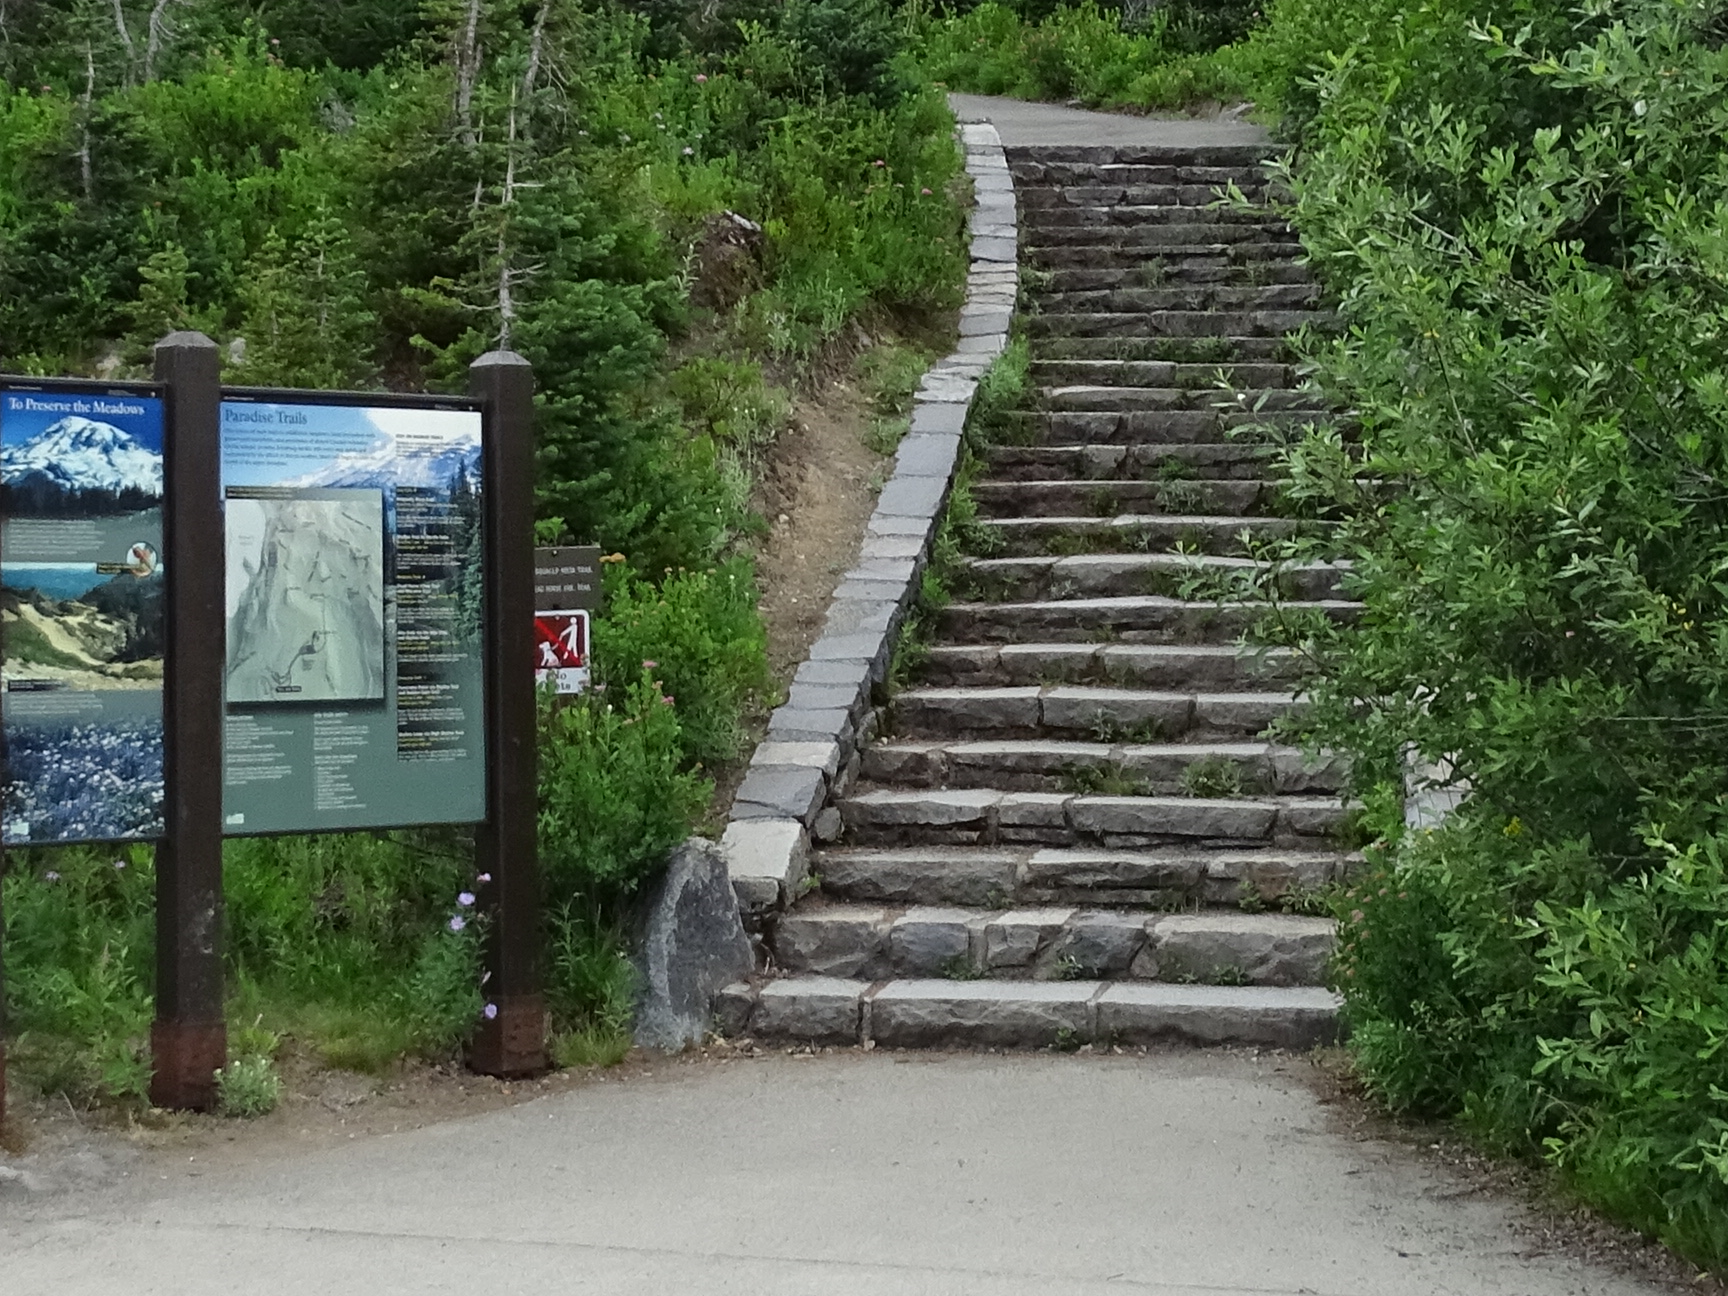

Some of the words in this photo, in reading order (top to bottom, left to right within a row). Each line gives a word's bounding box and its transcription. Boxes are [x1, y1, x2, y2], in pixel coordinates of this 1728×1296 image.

[8, 397, 22, 410] To
[26, 399, 71, 412] Preserve
[73, 400, 91, 412] the
[93, 400, 145, 415] Meadows
[224, 409, 274, 423] Paradise
[277, 410, 308, 425] Trails
